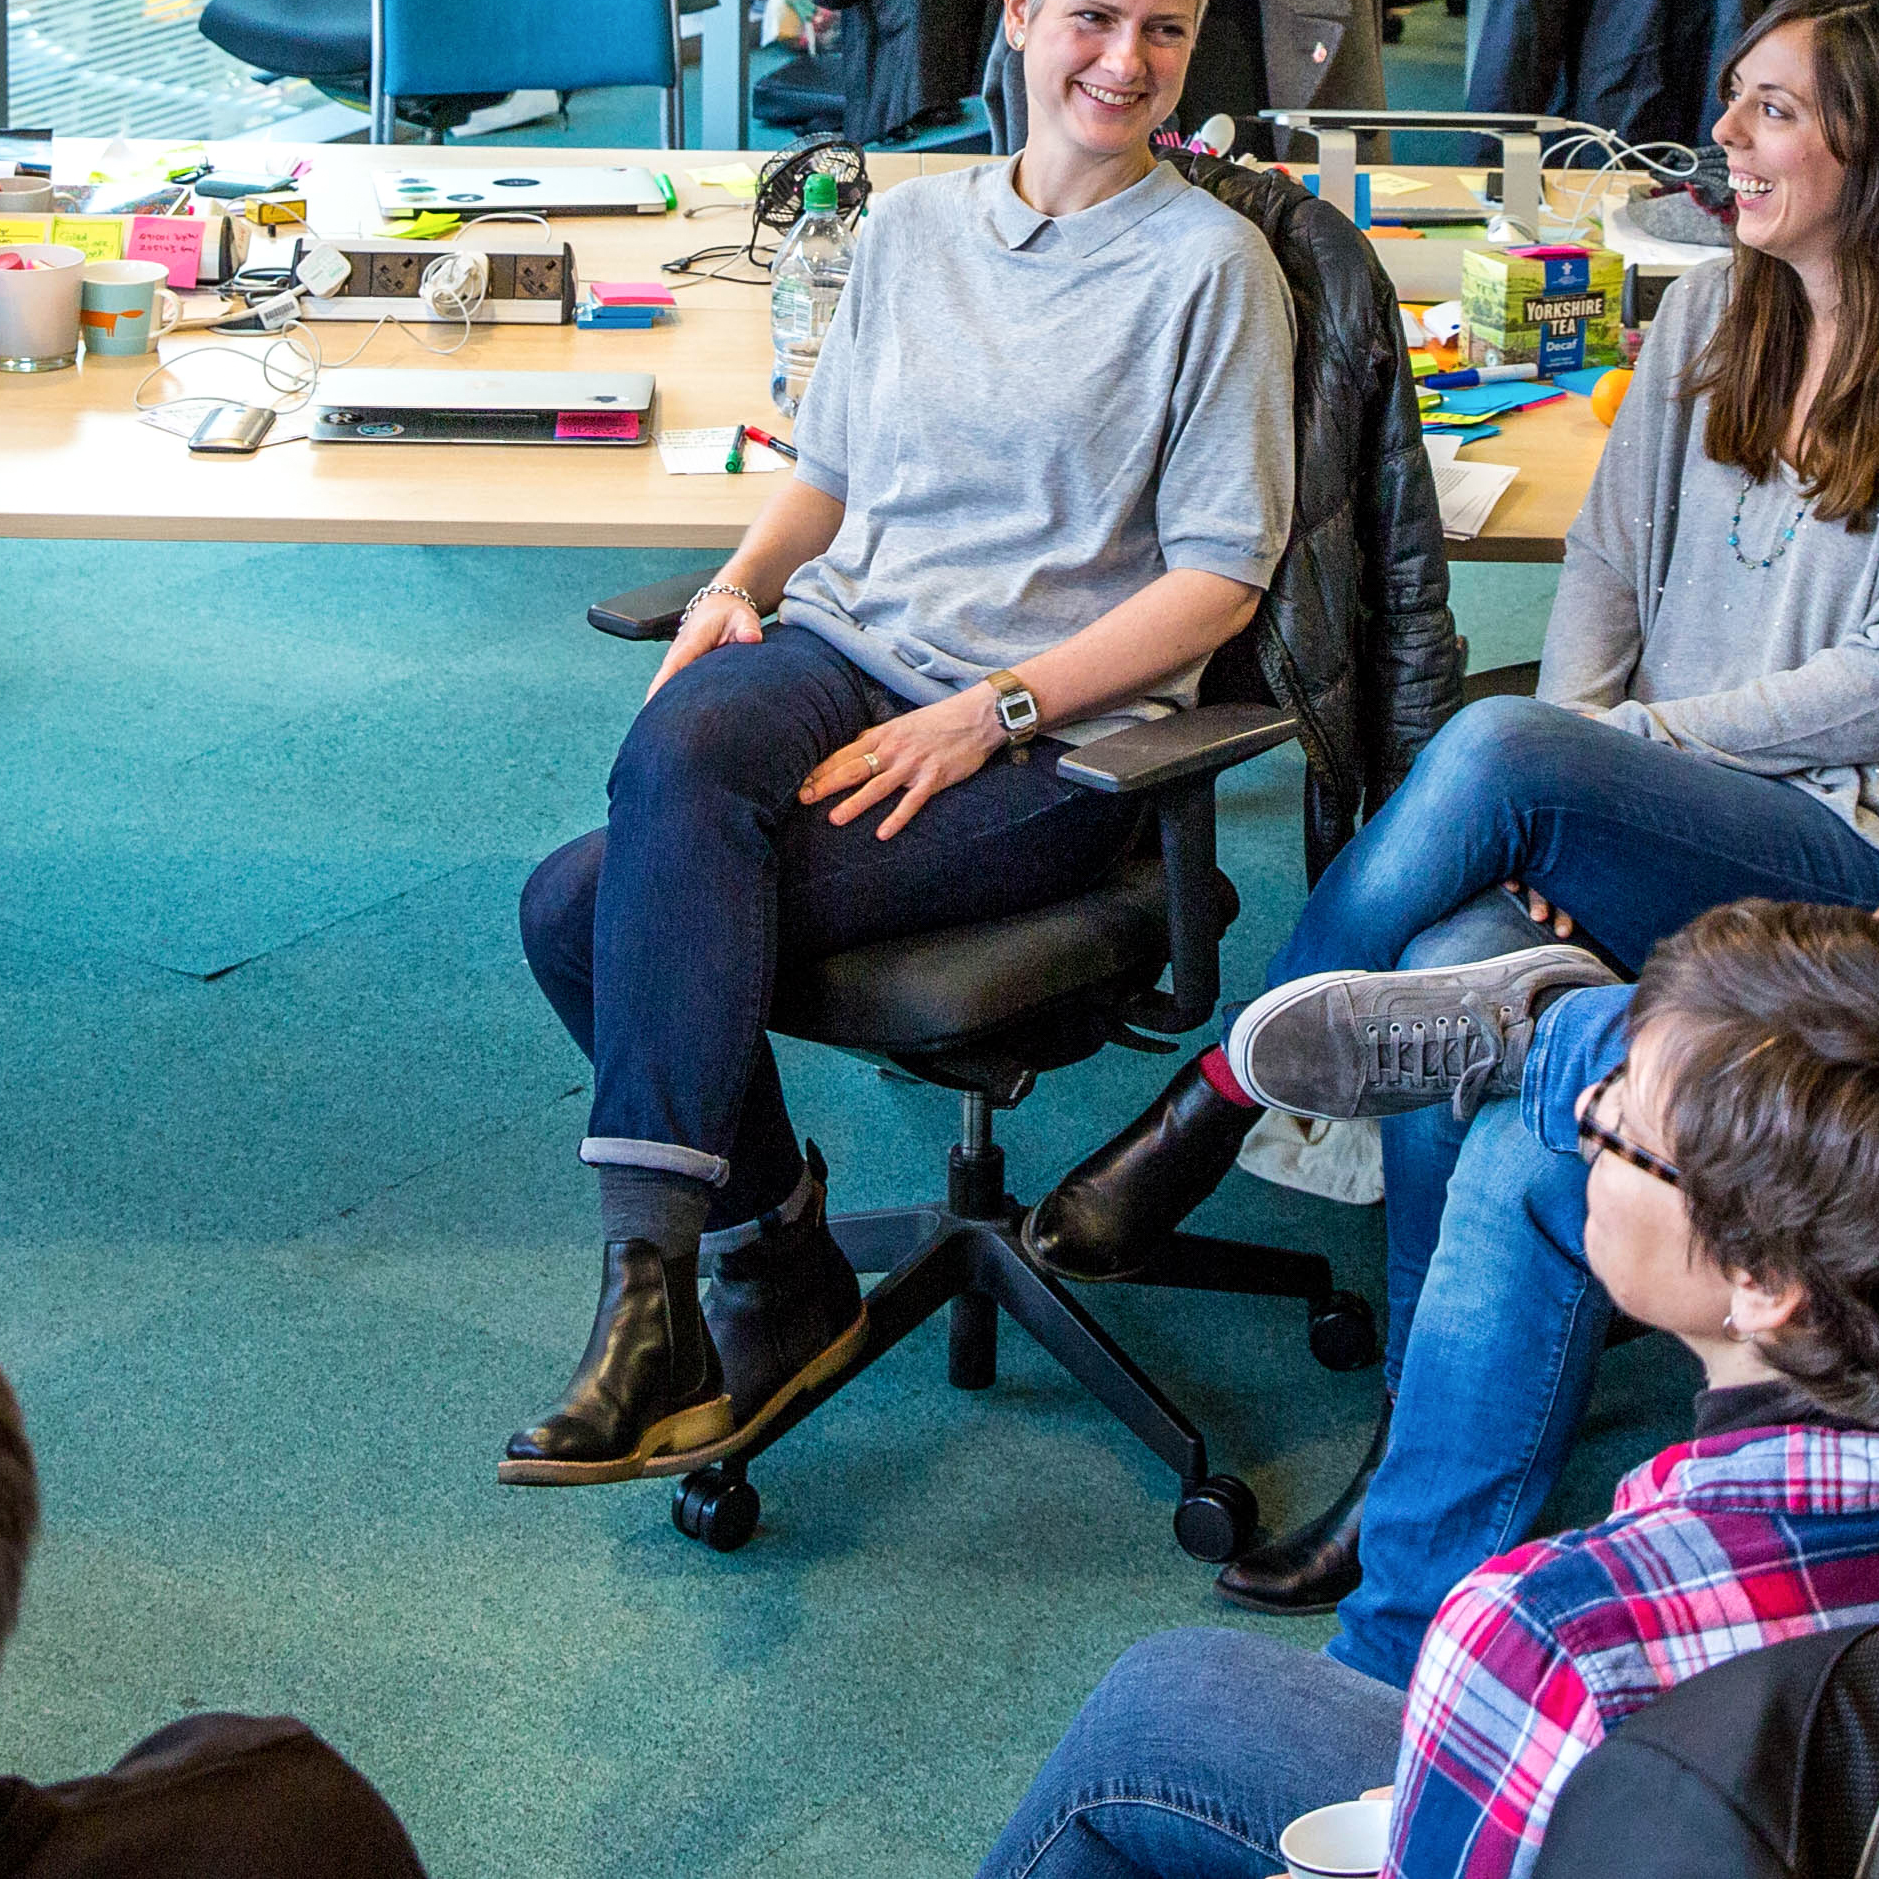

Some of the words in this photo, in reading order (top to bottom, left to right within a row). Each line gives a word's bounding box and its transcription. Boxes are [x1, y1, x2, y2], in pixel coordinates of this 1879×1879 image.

[1526, 298, 1603, 321] YORKSHIRE
[1551, 318, 1576, 336] TEA
[1545, 338, 1578, 352] Decaf
